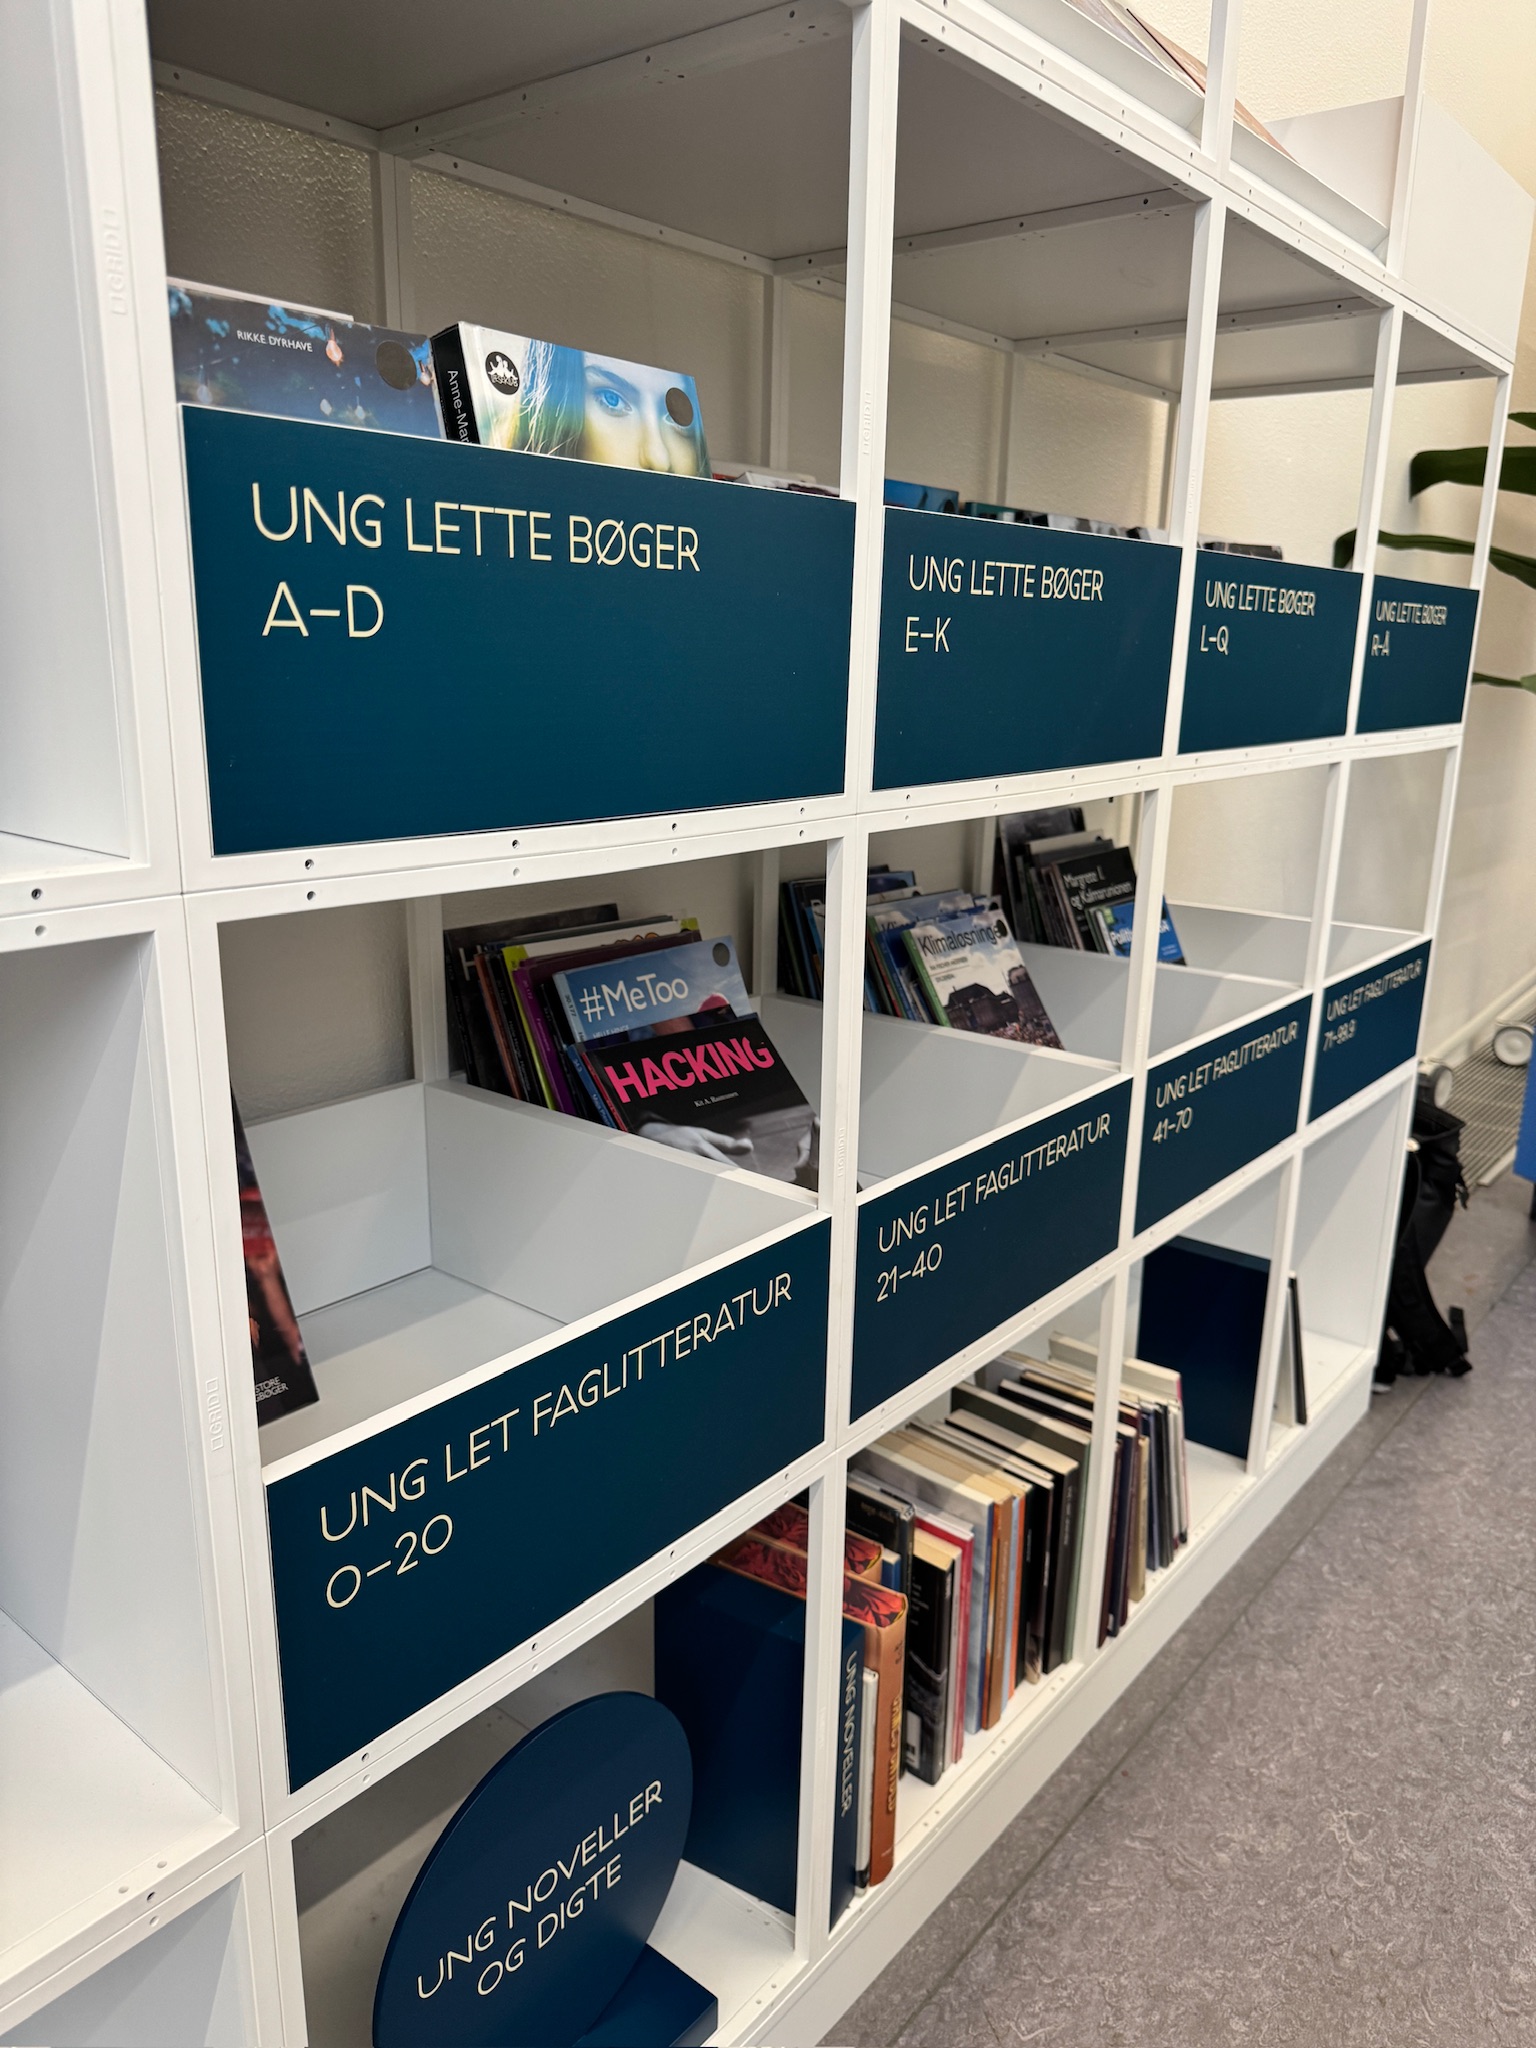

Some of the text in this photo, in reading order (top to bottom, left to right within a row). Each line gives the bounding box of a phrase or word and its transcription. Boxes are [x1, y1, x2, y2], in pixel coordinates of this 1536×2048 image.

[236, 330, 314, 353] RIKKE DYRHAVE
[447, 370, 472, 443] Anne-Mar
[251, 482, 701, 573] UNG LETTE BØGER
[909, 554, 1105, 602] UNG LETTE BØGER
[1205, 580, 1317, 617] UNG LETTE BØGER
[1375, 600, 1448, 627] UNG LETTE BØGER
[917, 924, 1003, 957] Klimaløsninge
[579, 972, 689, 1023] #MeToo
[1326, 958, 1424, 1022] UNG LET FAGLITTERATUR
[603, 1036, 775, 1104] HACKING
[1156, 1020, 1299, 1109] UNG LET FAGLITTERATUR
[878, 1112, 1111, 1254] UNG LET FAGLITTERATUR
[320, 1272, 793, 1543] UNG LET FAGLITTERATUR
[840, 1650, 858, 1818] UNG NOVELLER
[417, 1780, 663, 1999] UNG NOVELLER
[476, 1853, 622, 1996] OG DIGTE
